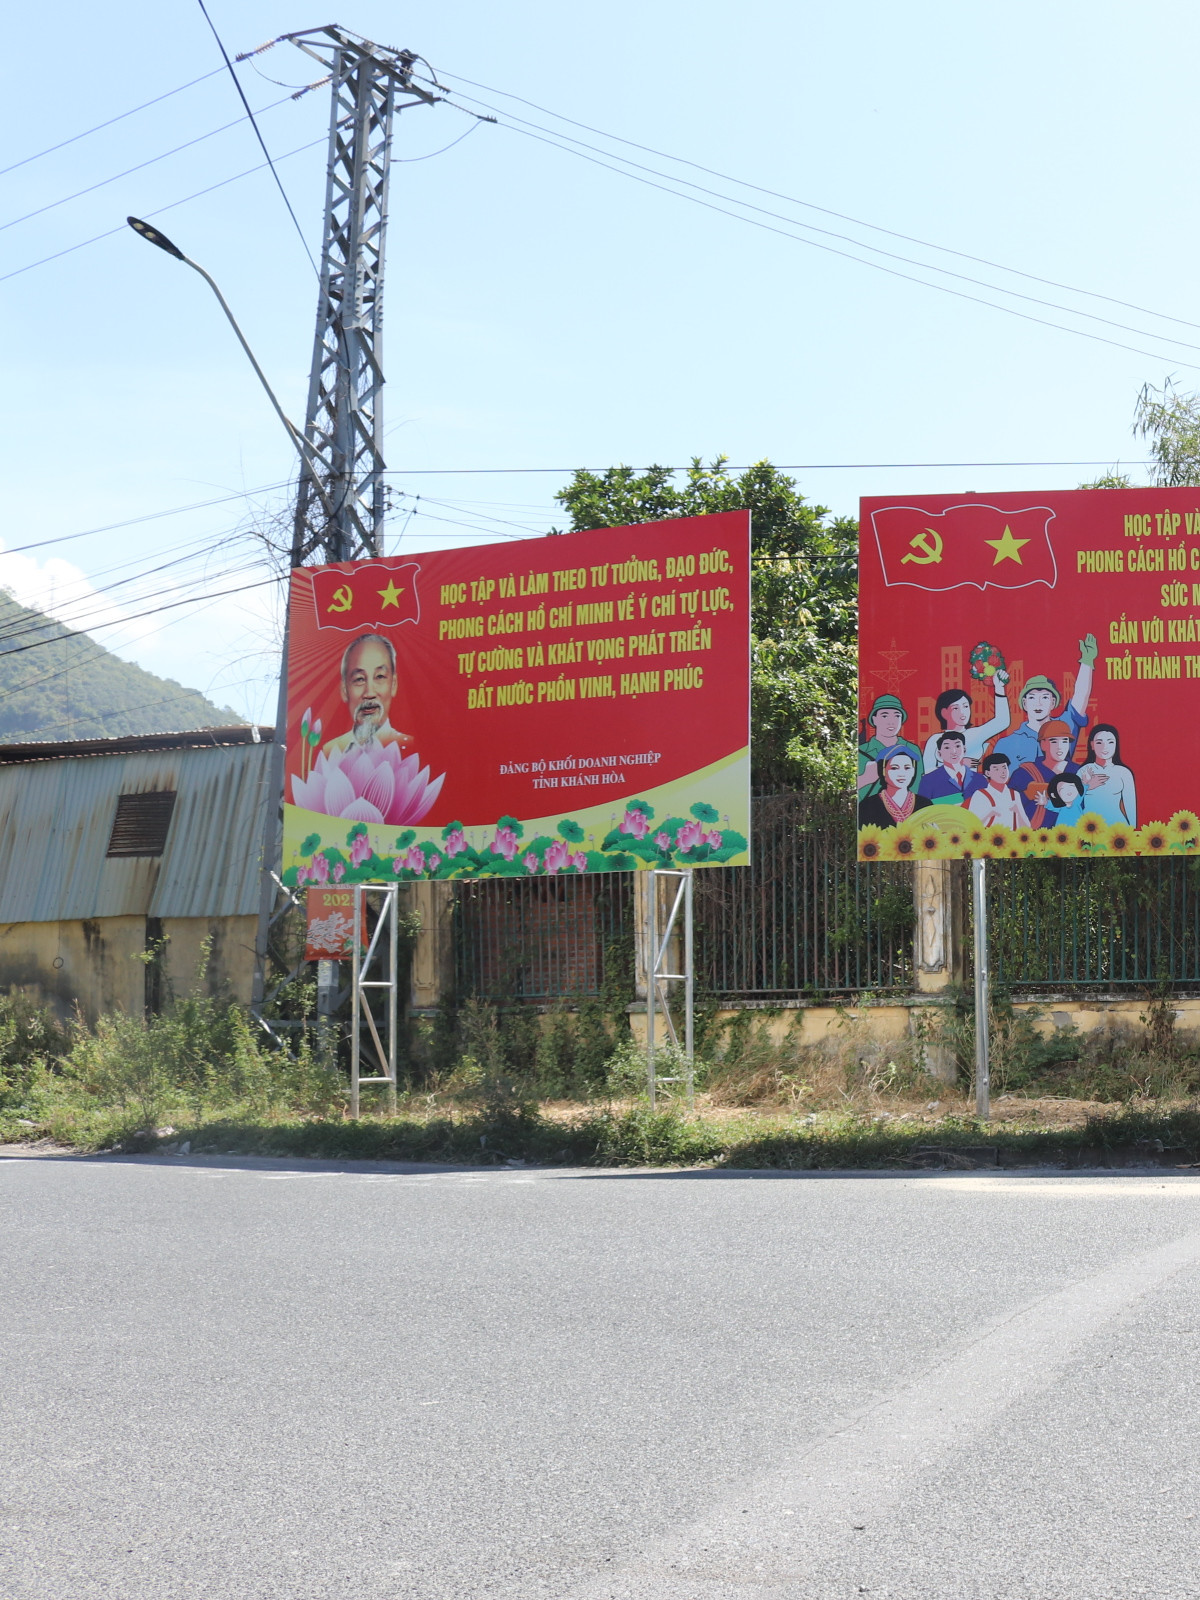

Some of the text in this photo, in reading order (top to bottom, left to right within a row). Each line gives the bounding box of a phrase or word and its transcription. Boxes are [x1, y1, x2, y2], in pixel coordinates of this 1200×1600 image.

[1124, 514, 1151, 541] HỌC
[1155, 509, 1180, 539] TẬP
[1078, 550, 1123, 572] PHONG
[1128, 545, 1164, 572] CÁCH
[1168, 542, 1186, 570] HỒ
[441, 548, 733, 608] HỌC TẬP VÀ LÀM THEO TƯ TƯỞNG, ĐẠO ĐỨC,
[1161, 580, 1188, 607] SỨC
[440, 588, 734, 640] PHONG CÁCH HỒ CHÍ MINH VỀ Ý CHÍ TỰ LỰC,
[1110, 613, 1138, 644] GẮN
[1142, 616, 1164, 643] VỚI
[458, 620, 711, 678] TỰ CƯỜNG VÀ KHÁT VỌNG PHÁT TRIỂN
[1106, 650, 1131, 680] TRỞ
[1135, 652, 1180, 679] THÀNH
[468, 663, 702, 708] ĐẤT NƯỚC PHỒN VINH, HẠNH PHÚC
[499, 750, 661, 775] ĐẢNG BỘ KHỐI DOANH NGHIỆP
[532, 770, 625, 789] TỈNH KHÁNH HÒA
[323, 894, 354, 906] 202
